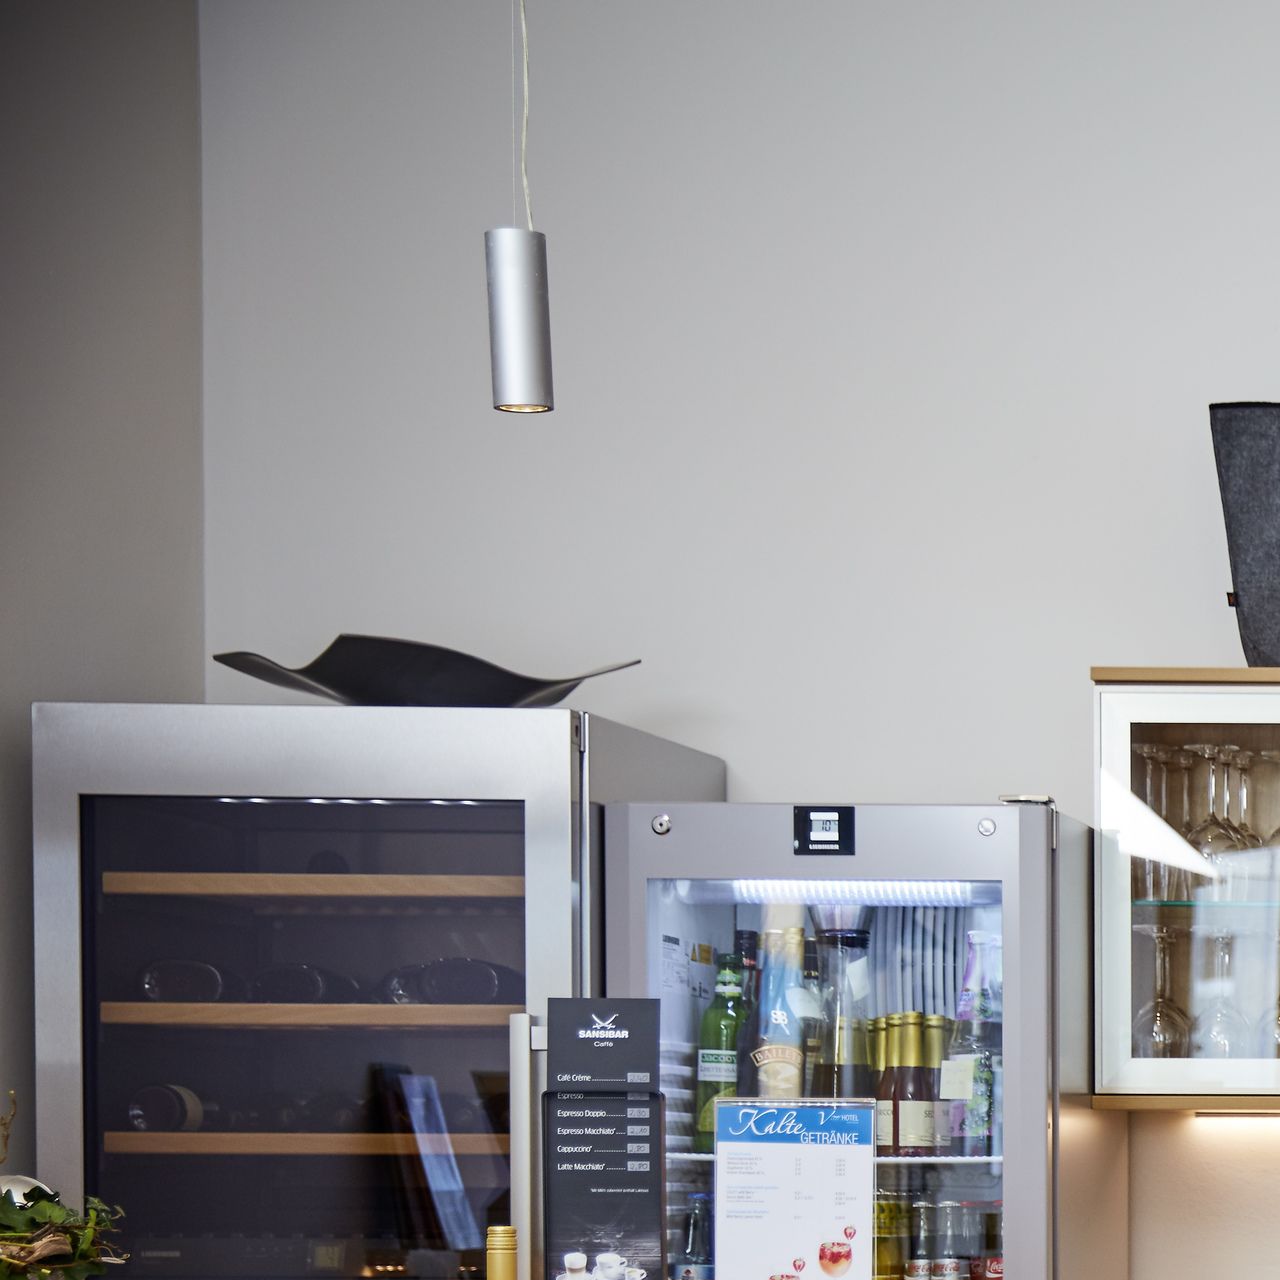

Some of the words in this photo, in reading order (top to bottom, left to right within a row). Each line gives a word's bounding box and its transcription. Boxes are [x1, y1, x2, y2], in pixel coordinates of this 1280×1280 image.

[578, 1030, 629, 1039] SANSIBAR
[557, 1074, 571, 1082] Café
[557, 1092, 584, 1100] Espresso
[557, 1109, 583, 1118] Espresso
[584, 1109, 607, 1118] Doppio
[841, 1114, 859, 1122] HOTEL
[728, 1108, 806, 1136] Kalte
[557, 1127, 584, 1136] Espresso
[800, 1131, 859, 1145] GETRÄNKE
[557, 1163, 573, 1171] Latte
